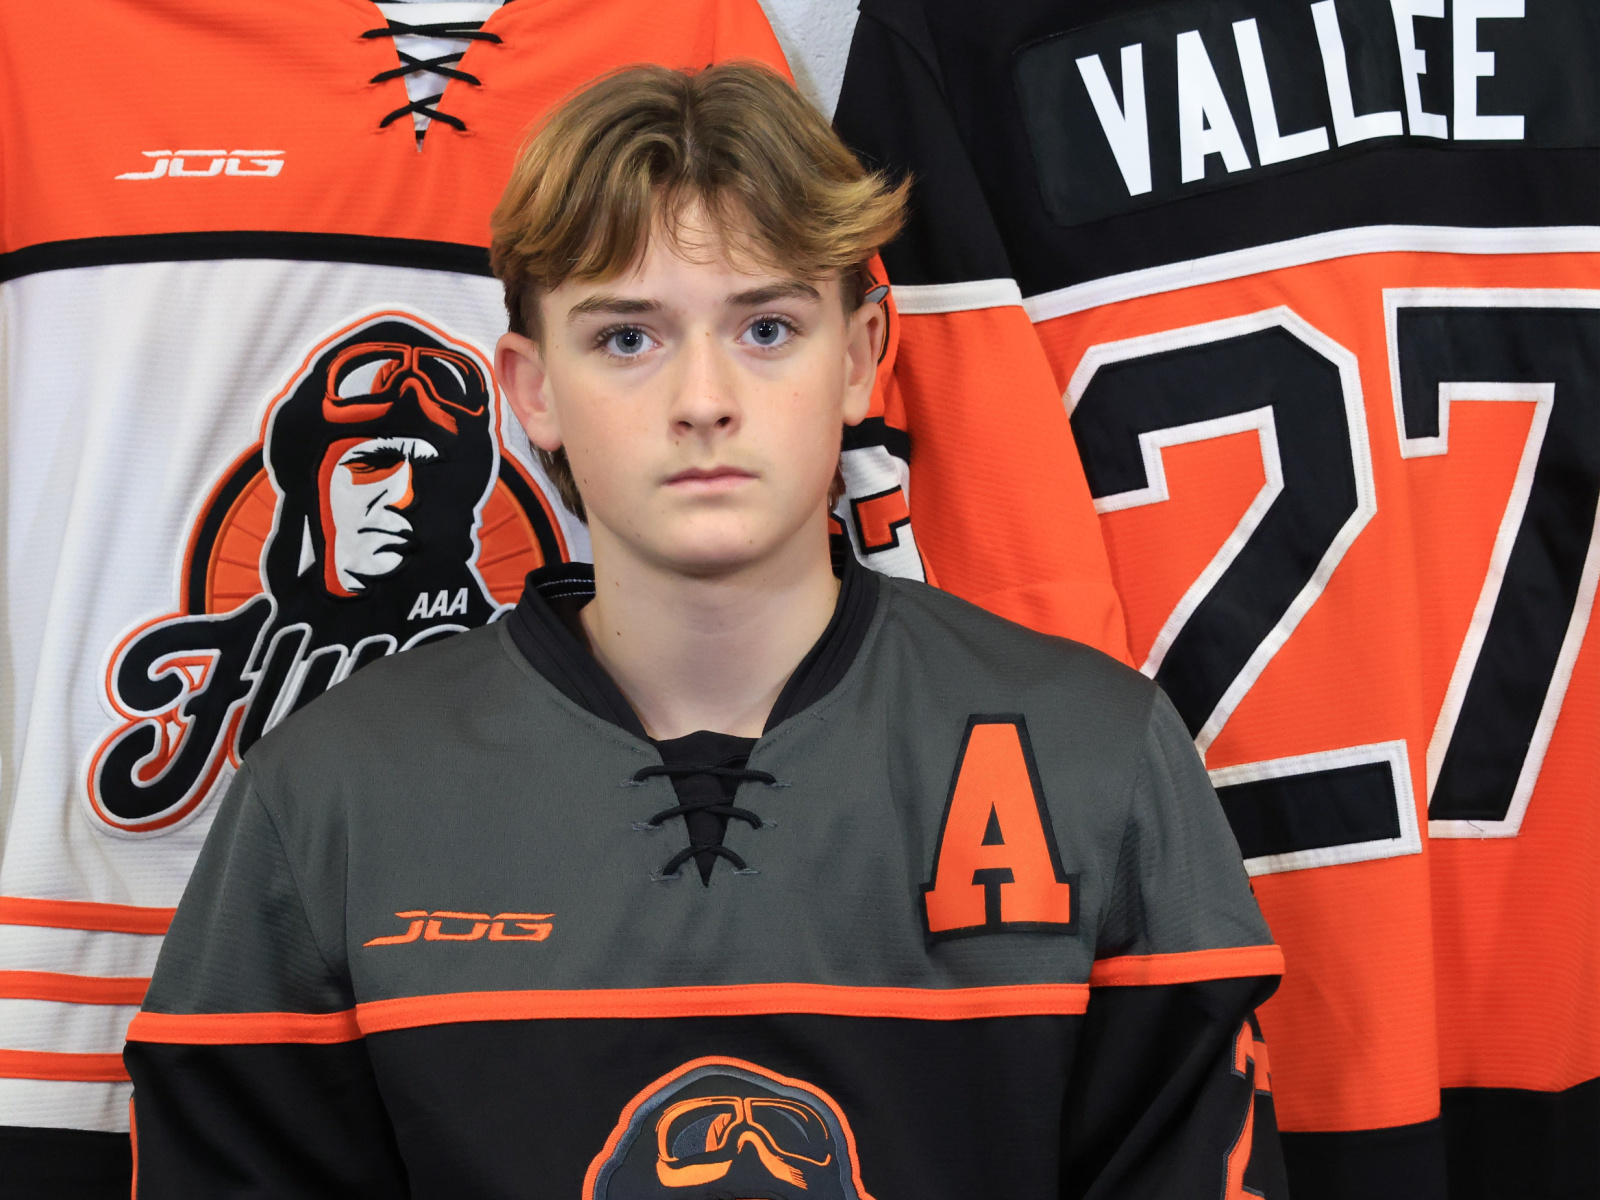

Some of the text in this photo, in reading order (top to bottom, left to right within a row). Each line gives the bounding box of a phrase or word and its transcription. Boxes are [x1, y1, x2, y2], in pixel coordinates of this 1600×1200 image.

[1075, 0, 1526, 196] VALLEE
[114, 149, 286, 180] JOG
[406, 587, 469, 621] AAA
[1061, 287, 1600, 876] 27
[919, 713, 1080, 941] A
[362, 909, 556, 947] JOG
